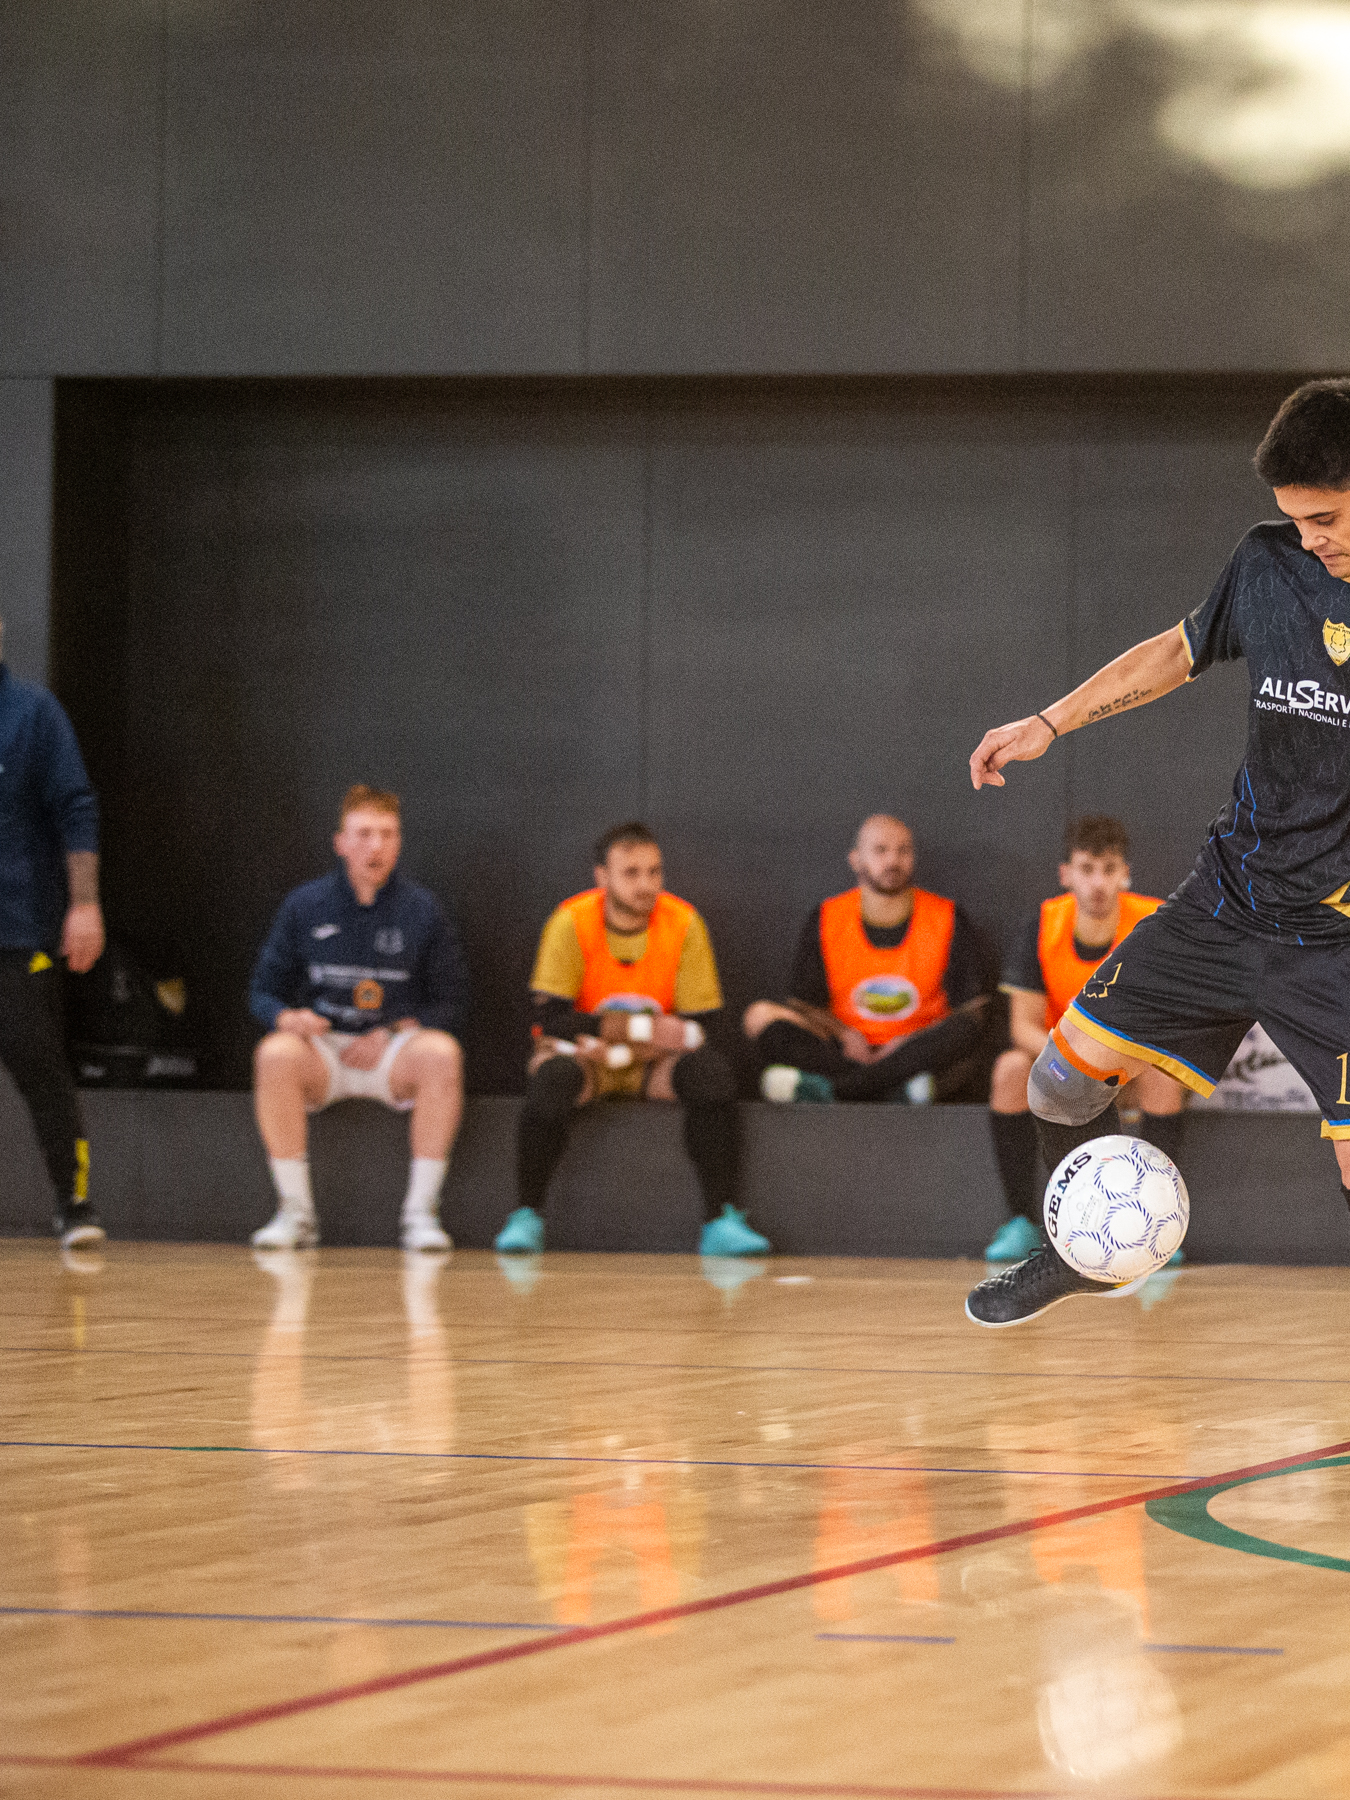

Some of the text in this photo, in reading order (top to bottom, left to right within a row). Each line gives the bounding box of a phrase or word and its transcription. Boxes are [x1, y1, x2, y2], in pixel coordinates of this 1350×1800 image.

[1254, 699, 1296, 715] RASPORTI
[1298, 709, 1340, 726] NAZIONALI
[1342, 719, 1347, 728] E
